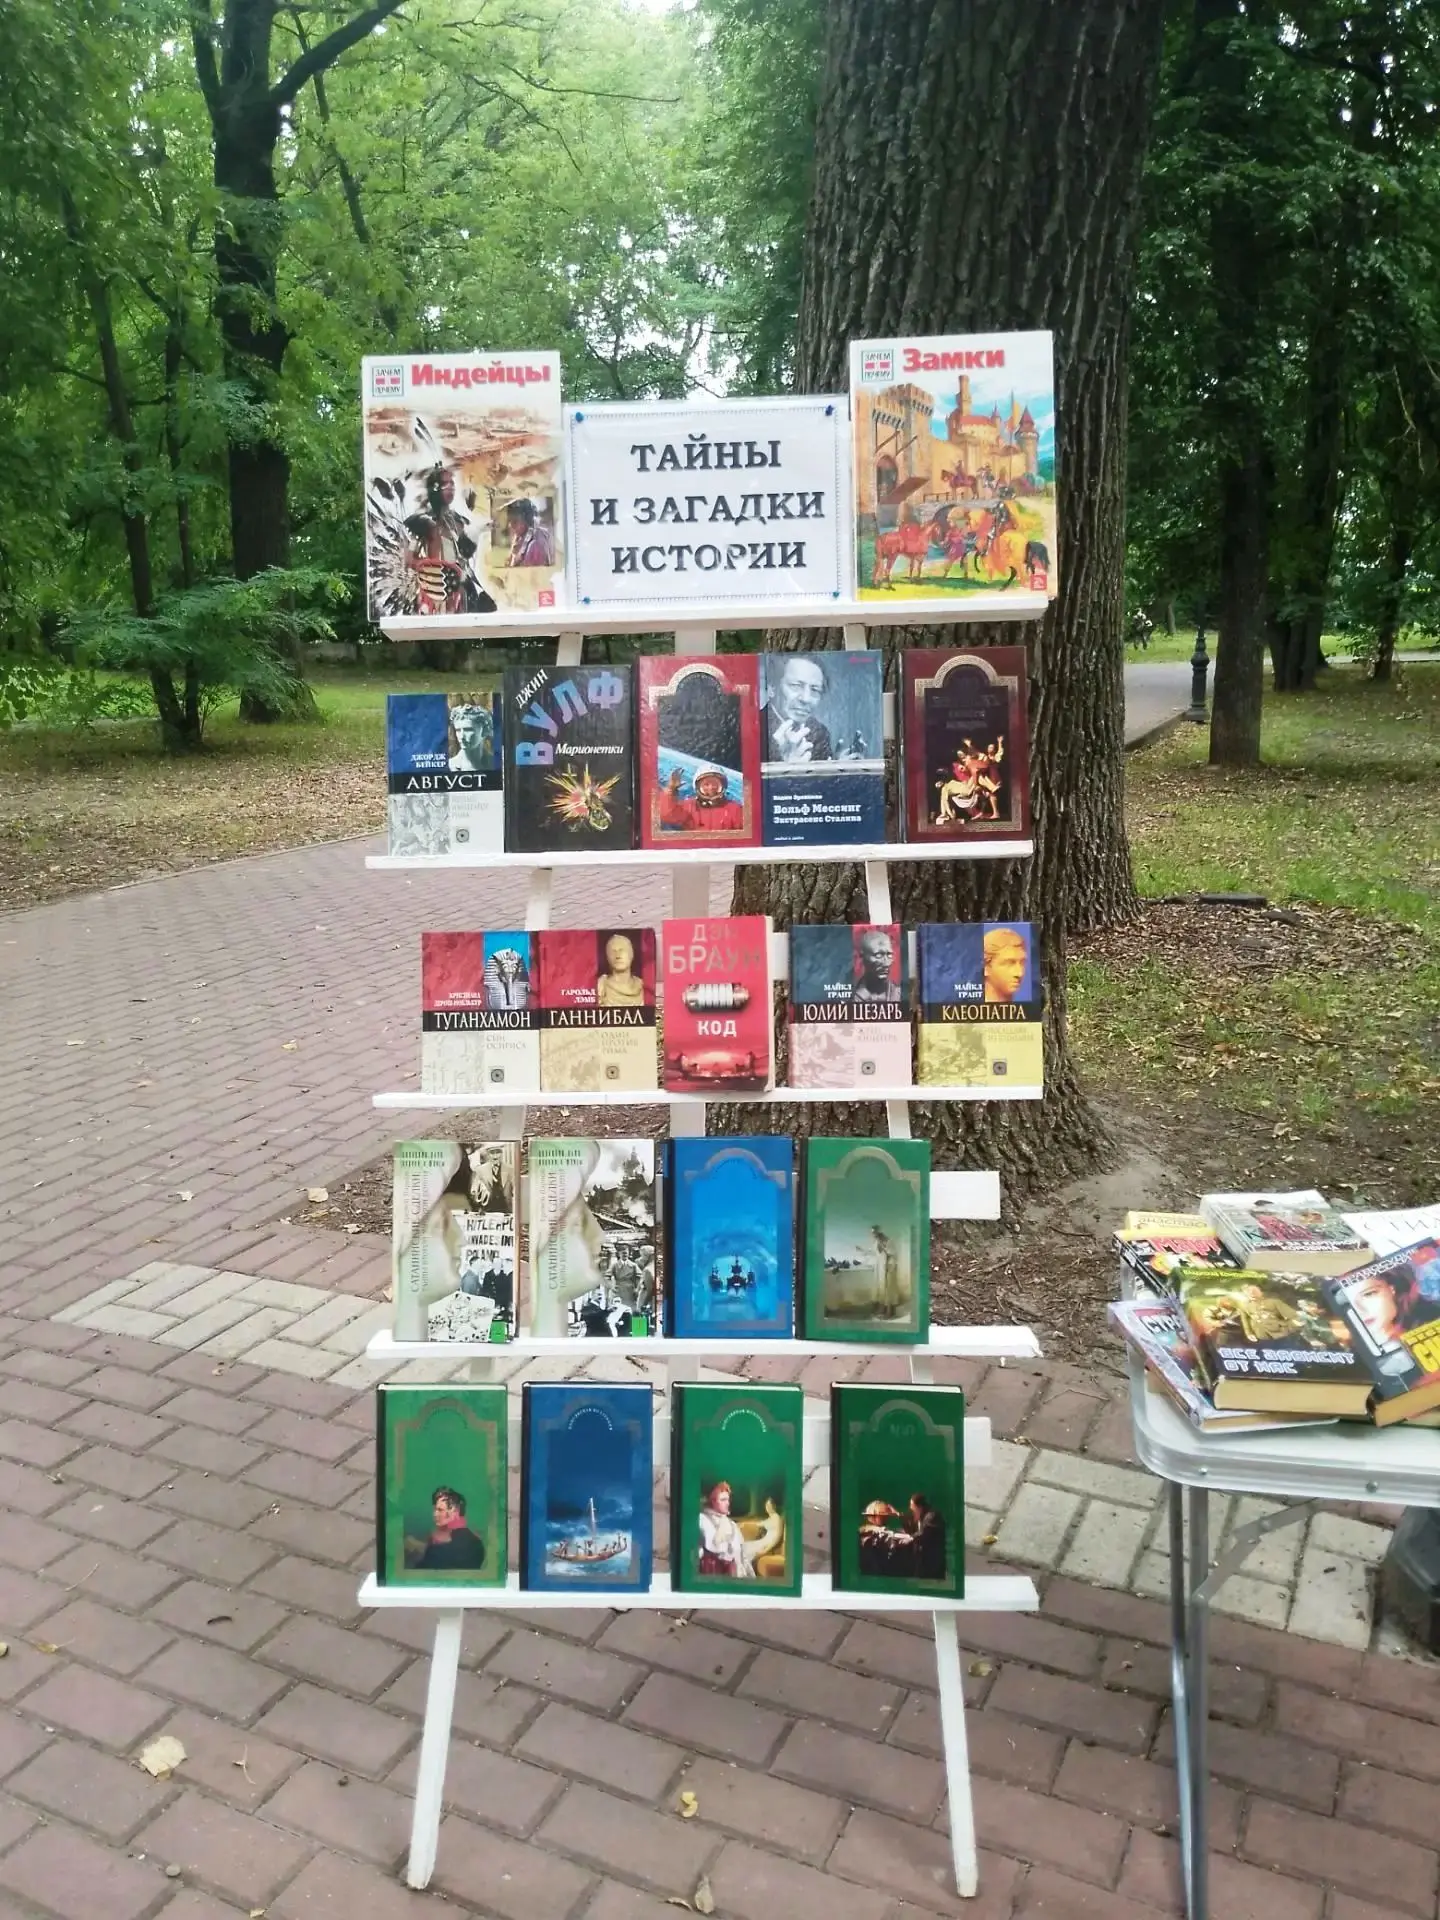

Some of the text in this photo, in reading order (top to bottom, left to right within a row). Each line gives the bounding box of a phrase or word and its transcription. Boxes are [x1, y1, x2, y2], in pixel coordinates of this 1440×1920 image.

[902, 348, 1005, 373] Замки
[411, 360, 551, 389] Индейцы
[630, 433, 782, 472] ТАЙНЫ
[590, 491, 825, 526] И ЗАГАДКИ
[611, 541, 807, 574] ИСТОРИИ
[515, 668, 549, 709] ДЖИН
[515, 671, 624, 766] ВУЛФ
[555, 743, 624, 757] Марионетки
[406, 774, 487, 790] АВГУСТ
[773, 803, 862, 815] Вольф Мессинг
[434, 1011, 531, 1030] ТУТАНХАМОН
[550, 1009, 645, 1026] ГАННИБАЛ
[803, 1001, 903, 1021] ЮЛИЙ ЦЕЗАРЬ
[942, 1004, 1027, 1021] КЛЕОПАТРА
[696, 1020, 738, 1038] КОД
[1217, 1347, 1261, 1360] ВСЕ
[1223, 1360, 1299, 1374] ОТ НАС
